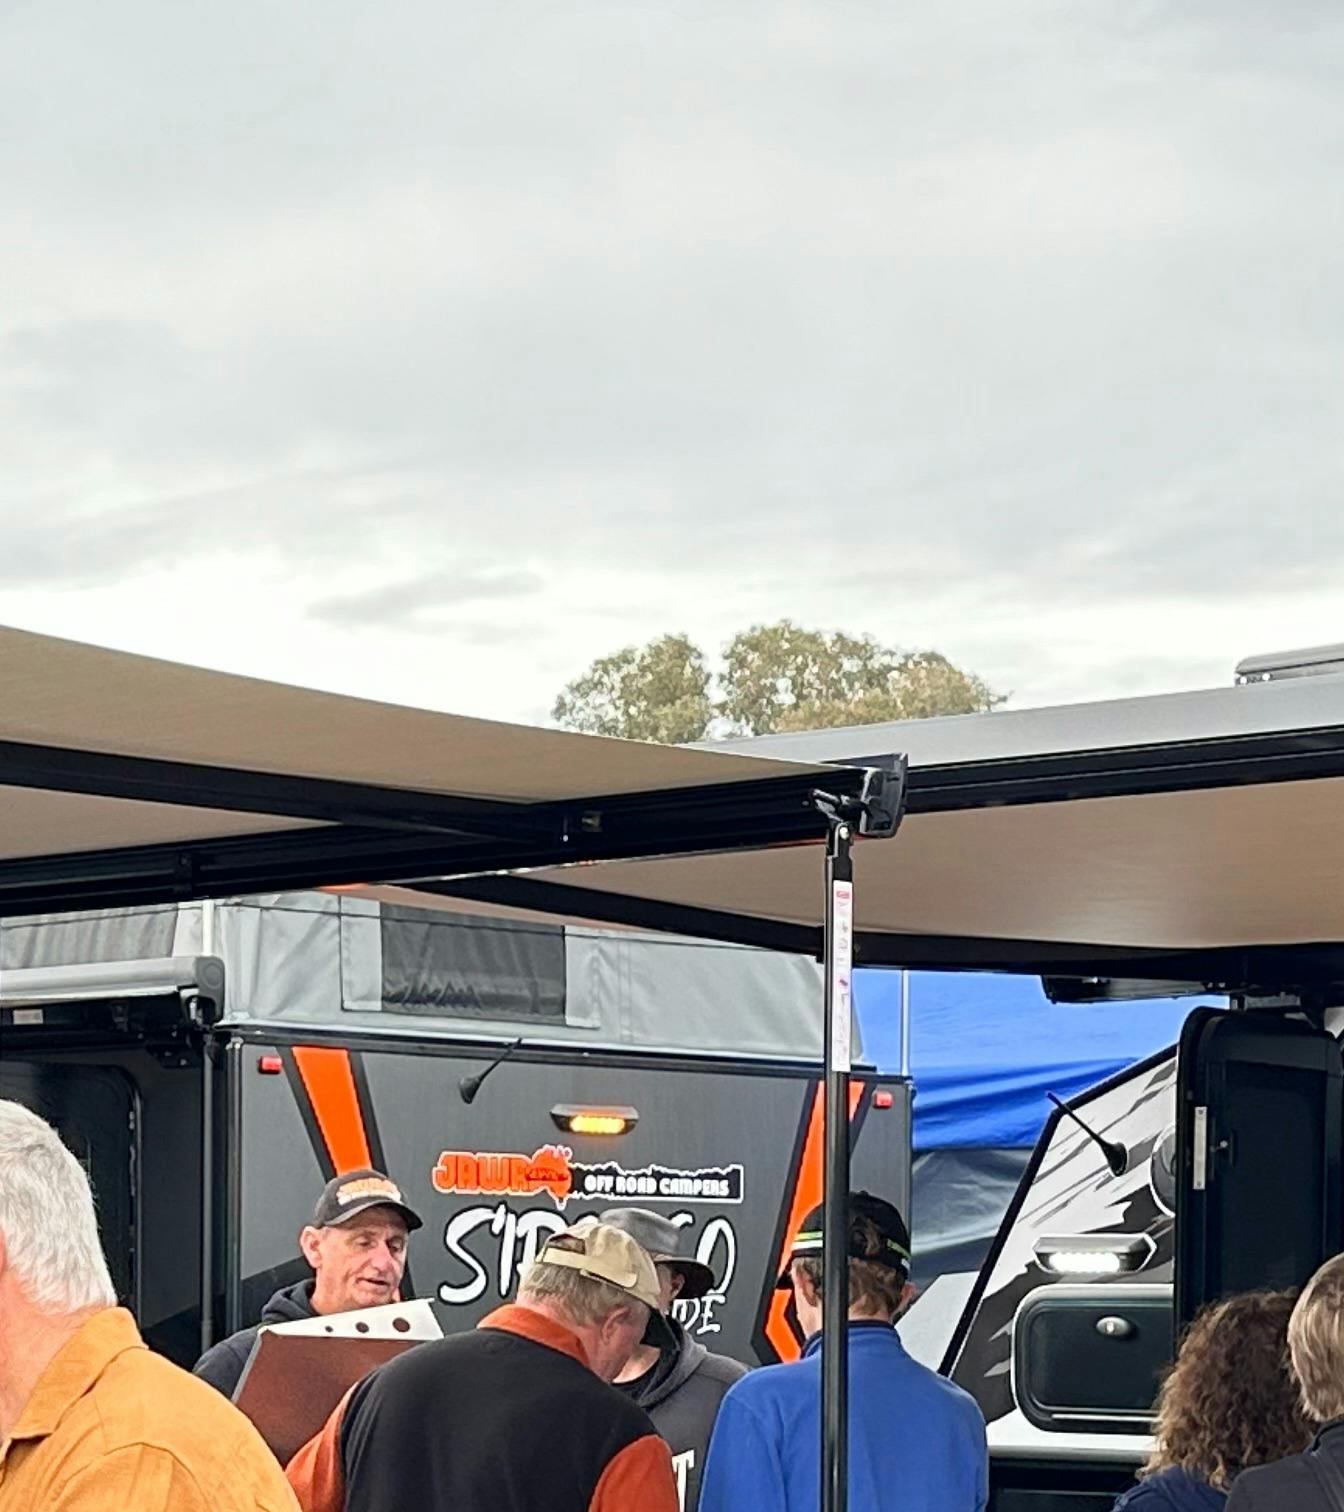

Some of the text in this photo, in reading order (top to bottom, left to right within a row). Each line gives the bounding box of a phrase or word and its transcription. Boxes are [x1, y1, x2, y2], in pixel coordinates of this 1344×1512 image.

[584, 1174, 614, 1192] OFF
[615, 1175, 657, 1194] ROAD
[659, 1178, 730, 1197] CAMPERS
